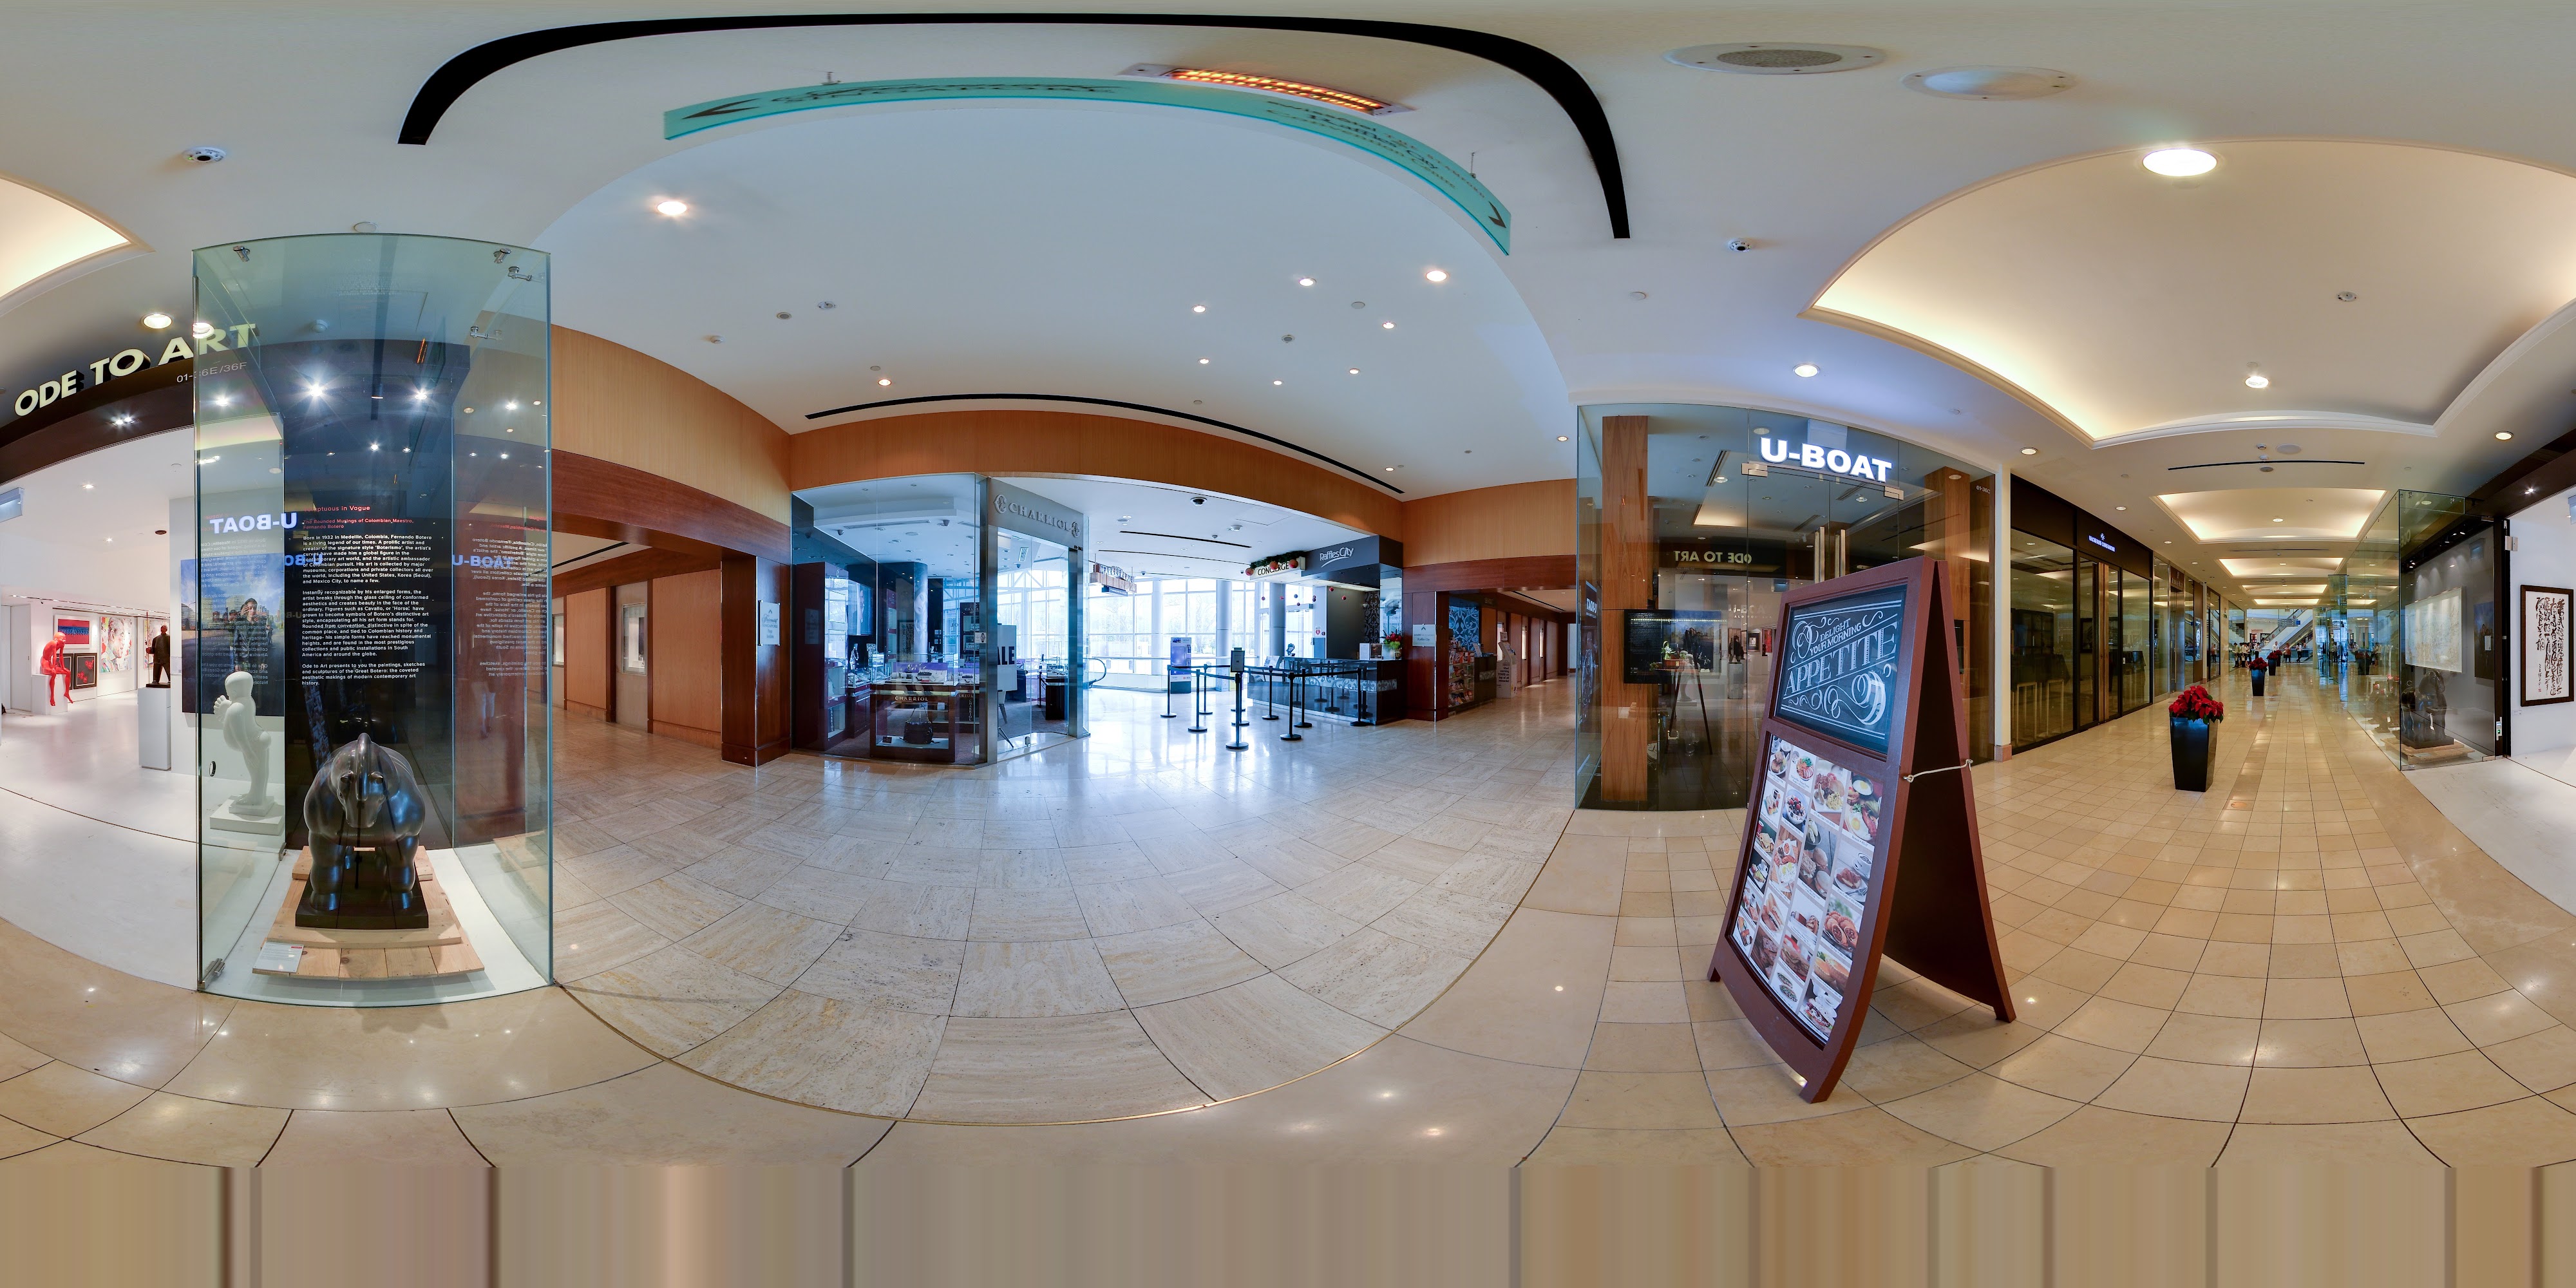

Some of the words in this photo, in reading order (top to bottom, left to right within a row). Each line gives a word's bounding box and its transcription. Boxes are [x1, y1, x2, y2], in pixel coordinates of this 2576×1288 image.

[1267, 109, 1405, 156] Convention
[1410, 157, 1455, 189] Centre
[1309, 115, 1397, 148] Raffles
[1406, 149, 1438, 169] City
[14, 370, 78, 417] ODE
[90, 348, 145, 386] TO
[158, 323, 257, 366] ART
[1761, 437, 1892, 482] U-BOAT
[1976, 485, 1991, 494] 01-36C
[1009, 502, 1071, 532] CHARRIOL
[1258, 562, 1289, 576] CONCRGE
[1810, 642, 1827, 656] YOUR
[1827, 622, 1862, 649] MORNING
[1820, 618, 1851, 642] DELIGHT
[1784, 621, 1898, 696] APPETITE
